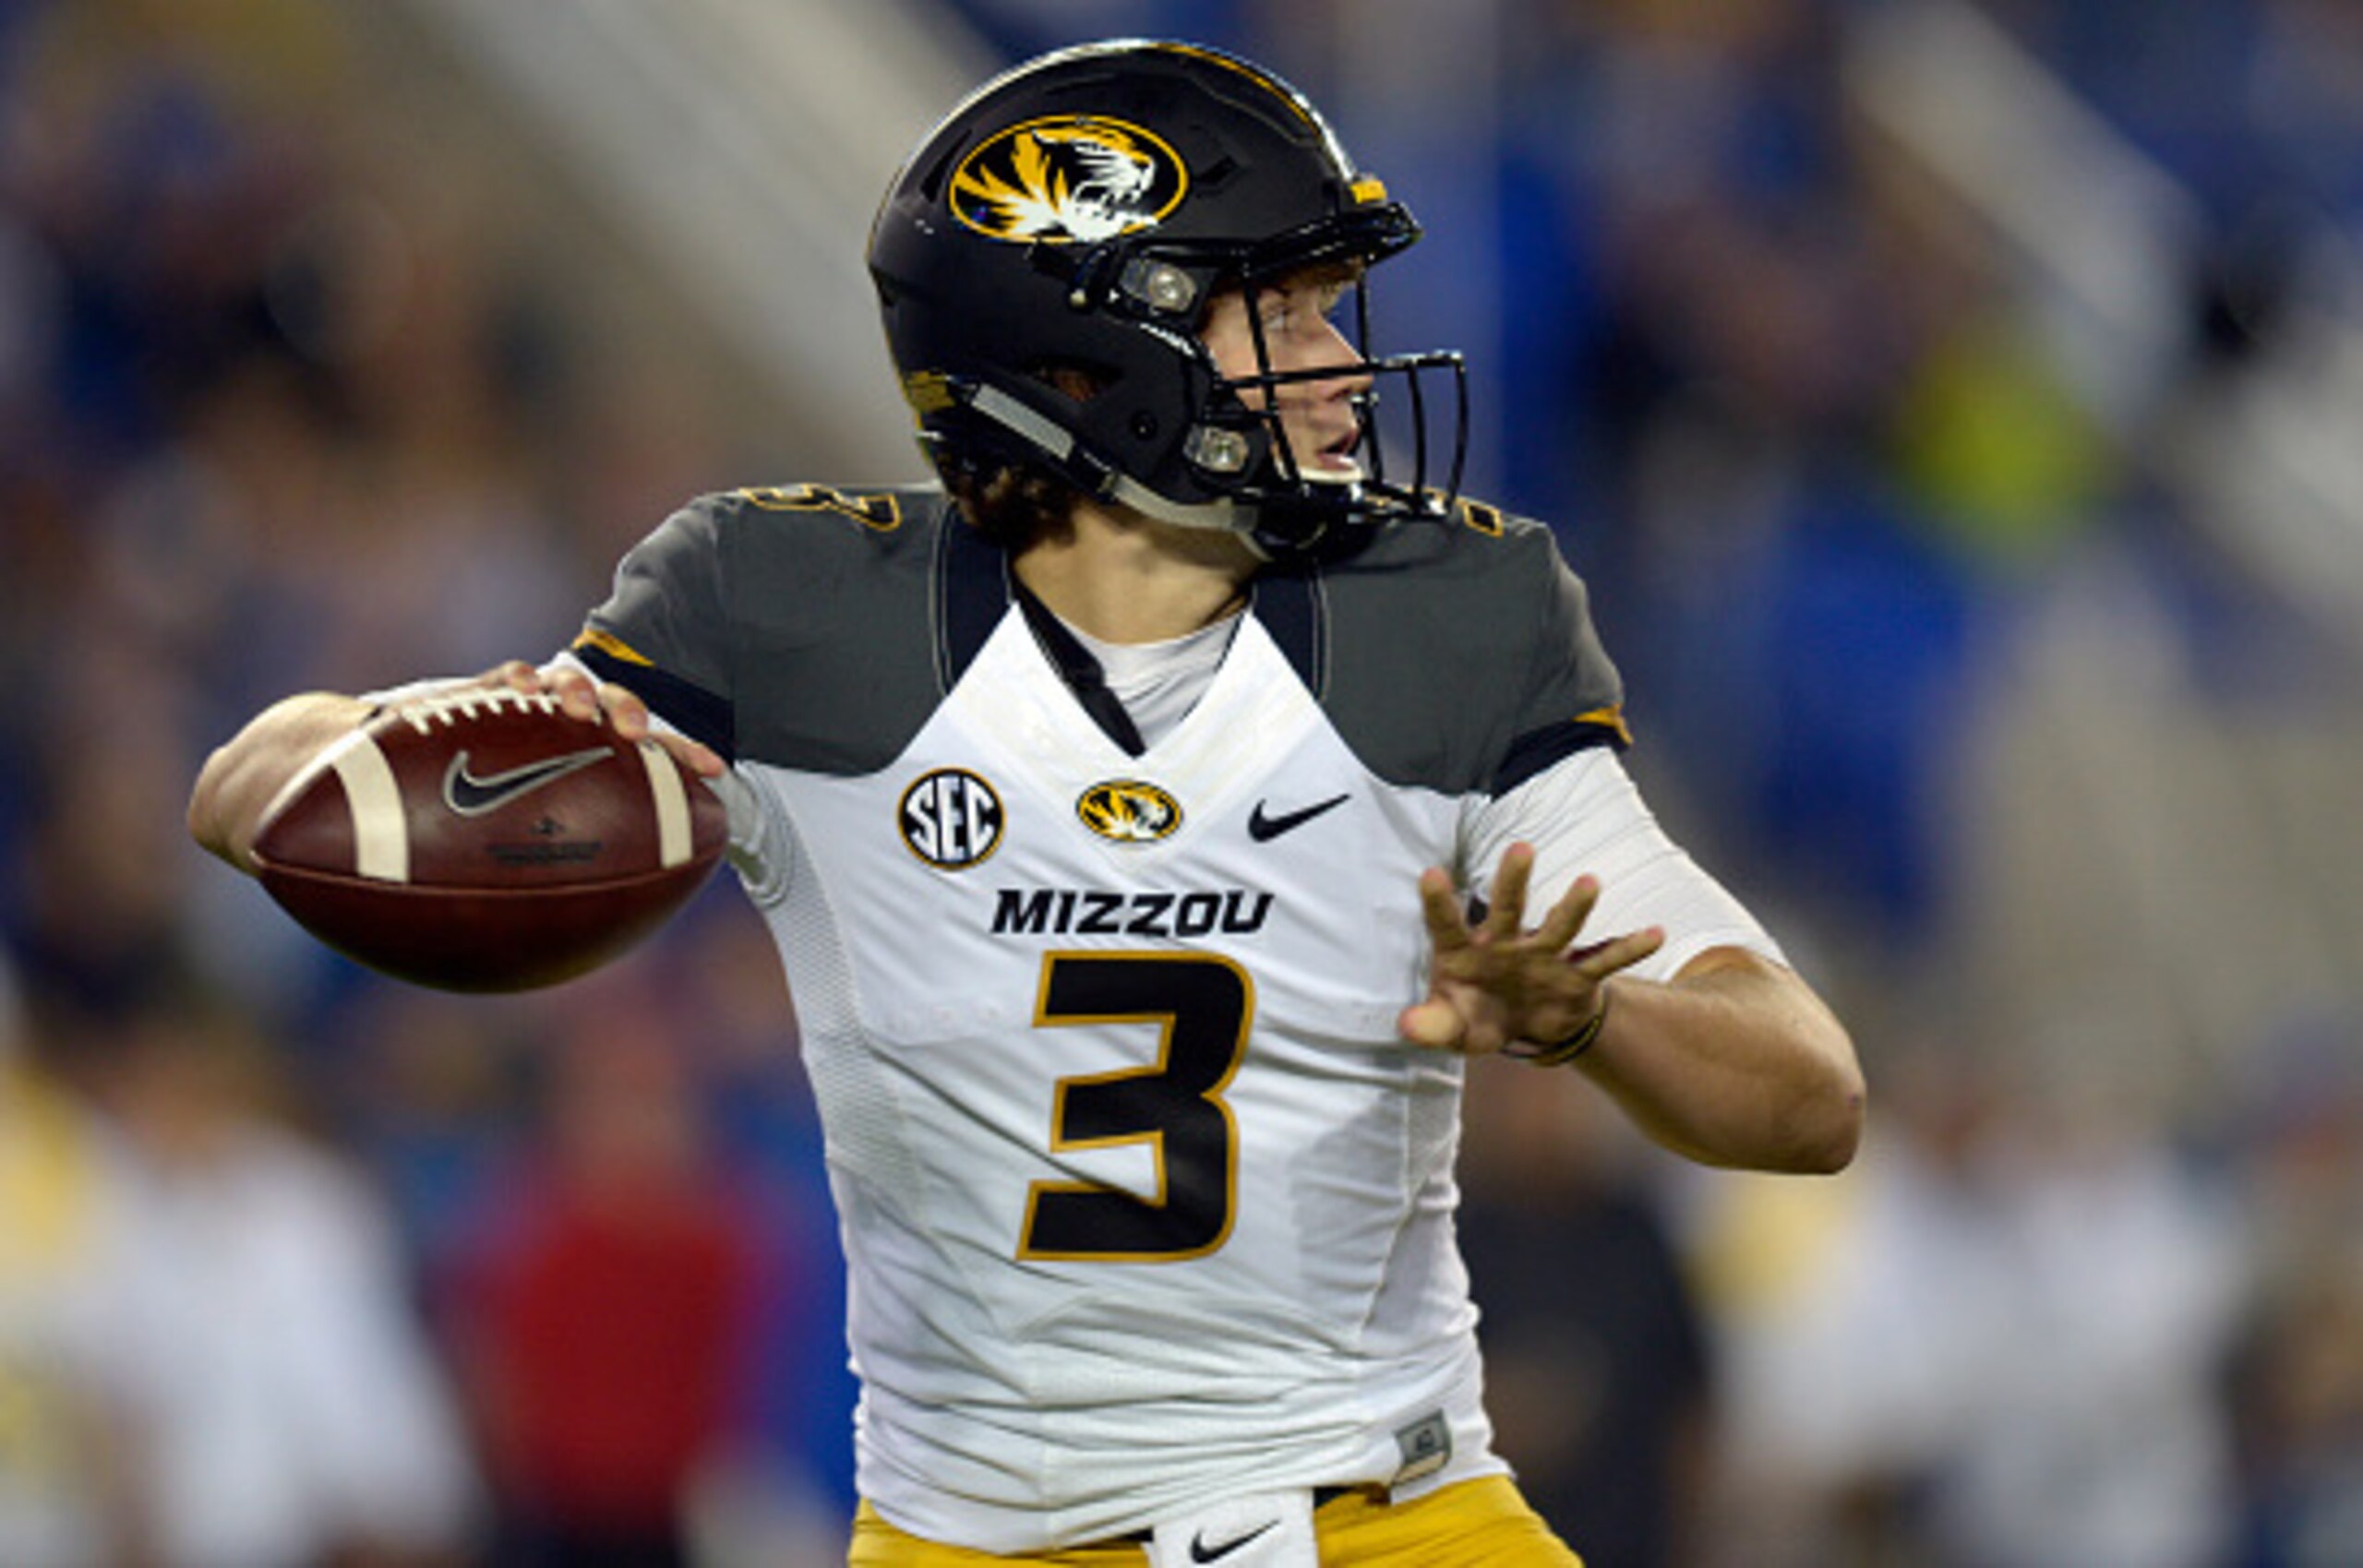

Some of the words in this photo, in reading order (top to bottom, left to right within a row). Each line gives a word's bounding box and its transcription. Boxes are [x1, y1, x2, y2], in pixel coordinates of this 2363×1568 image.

[906, 775, 994, 860] SEC
[990, 889, 1275, 937] MIZZOU
[1016, 950, 1255, 1263] 3
